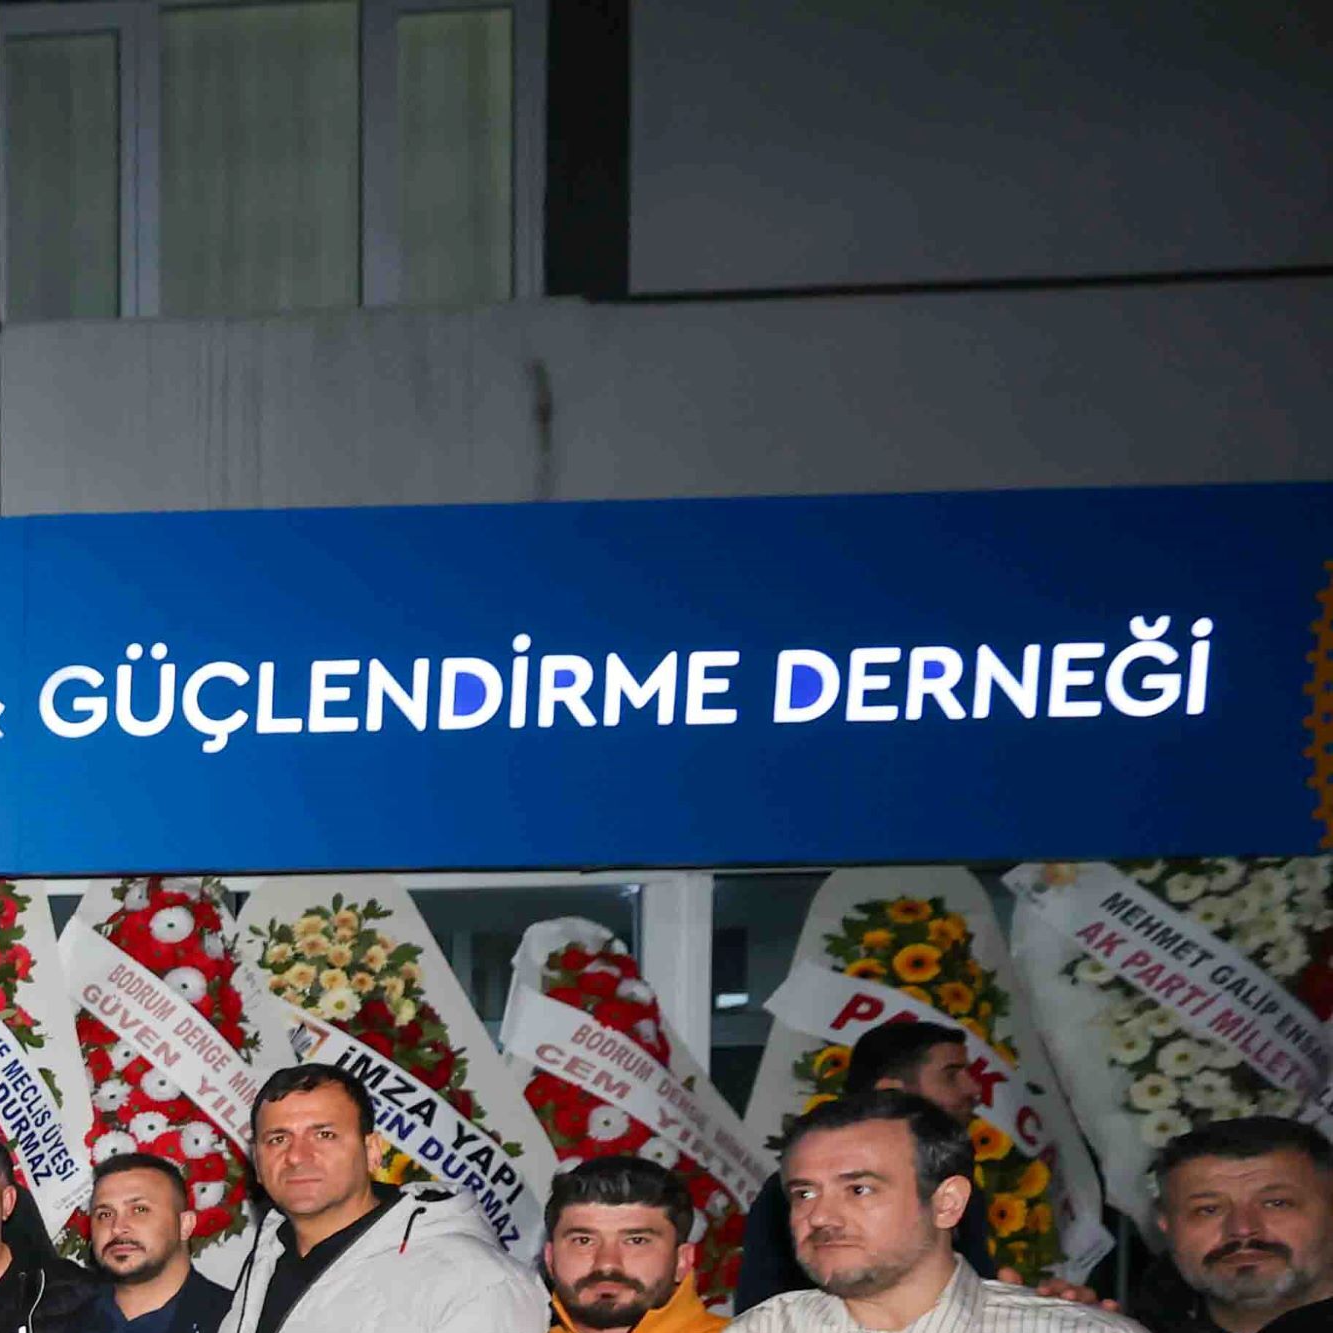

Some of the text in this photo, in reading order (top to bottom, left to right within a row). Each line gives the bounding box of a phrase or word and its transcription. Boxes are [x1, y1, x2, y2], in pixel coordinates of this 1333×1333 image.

[38, 632, 742, 754] GÜÇLENDİRME
[772, 614, 1215, 723] DERNEĞİ
[1075, 920, 1128, 959] AK
[1120, 948, 1223, 1018] PARTİ
[1098, 890, 1215, 969] MEHMET
[1209, 963, 1282, 1018] GALİP
[82, 983, 182, 1067] GÜVEN
[107, 963, 179, 1023] BODRUM
[172, 1016, 232, 1074] DENGE
[570, 1023, 656, 1083] BODRUM
[535, 1043, 633, 1100] CEM
[417, 1134, 521, 1252] DURMAZ
[451, 1120, 524, 1206] YAPI
